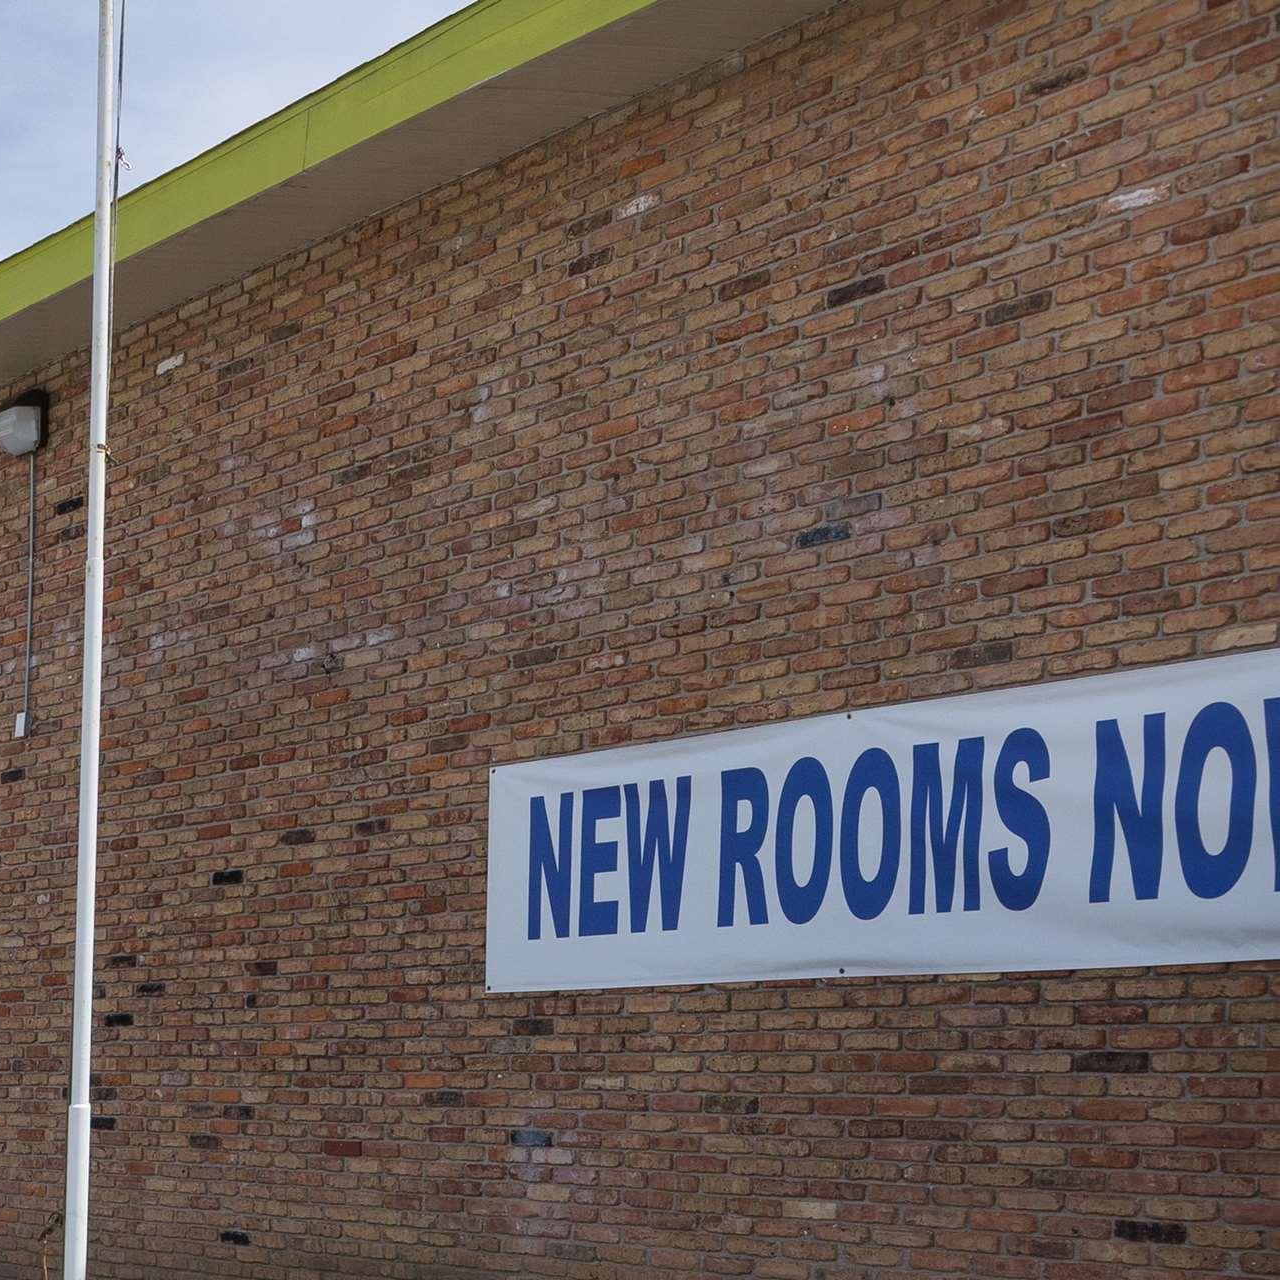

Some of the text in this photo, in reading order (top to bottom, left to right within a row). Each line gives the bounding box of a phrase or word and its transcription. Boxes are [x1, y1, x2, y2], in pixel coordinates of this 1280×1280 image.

[528, 697, 1280, 940] NEW ROOMS NO
